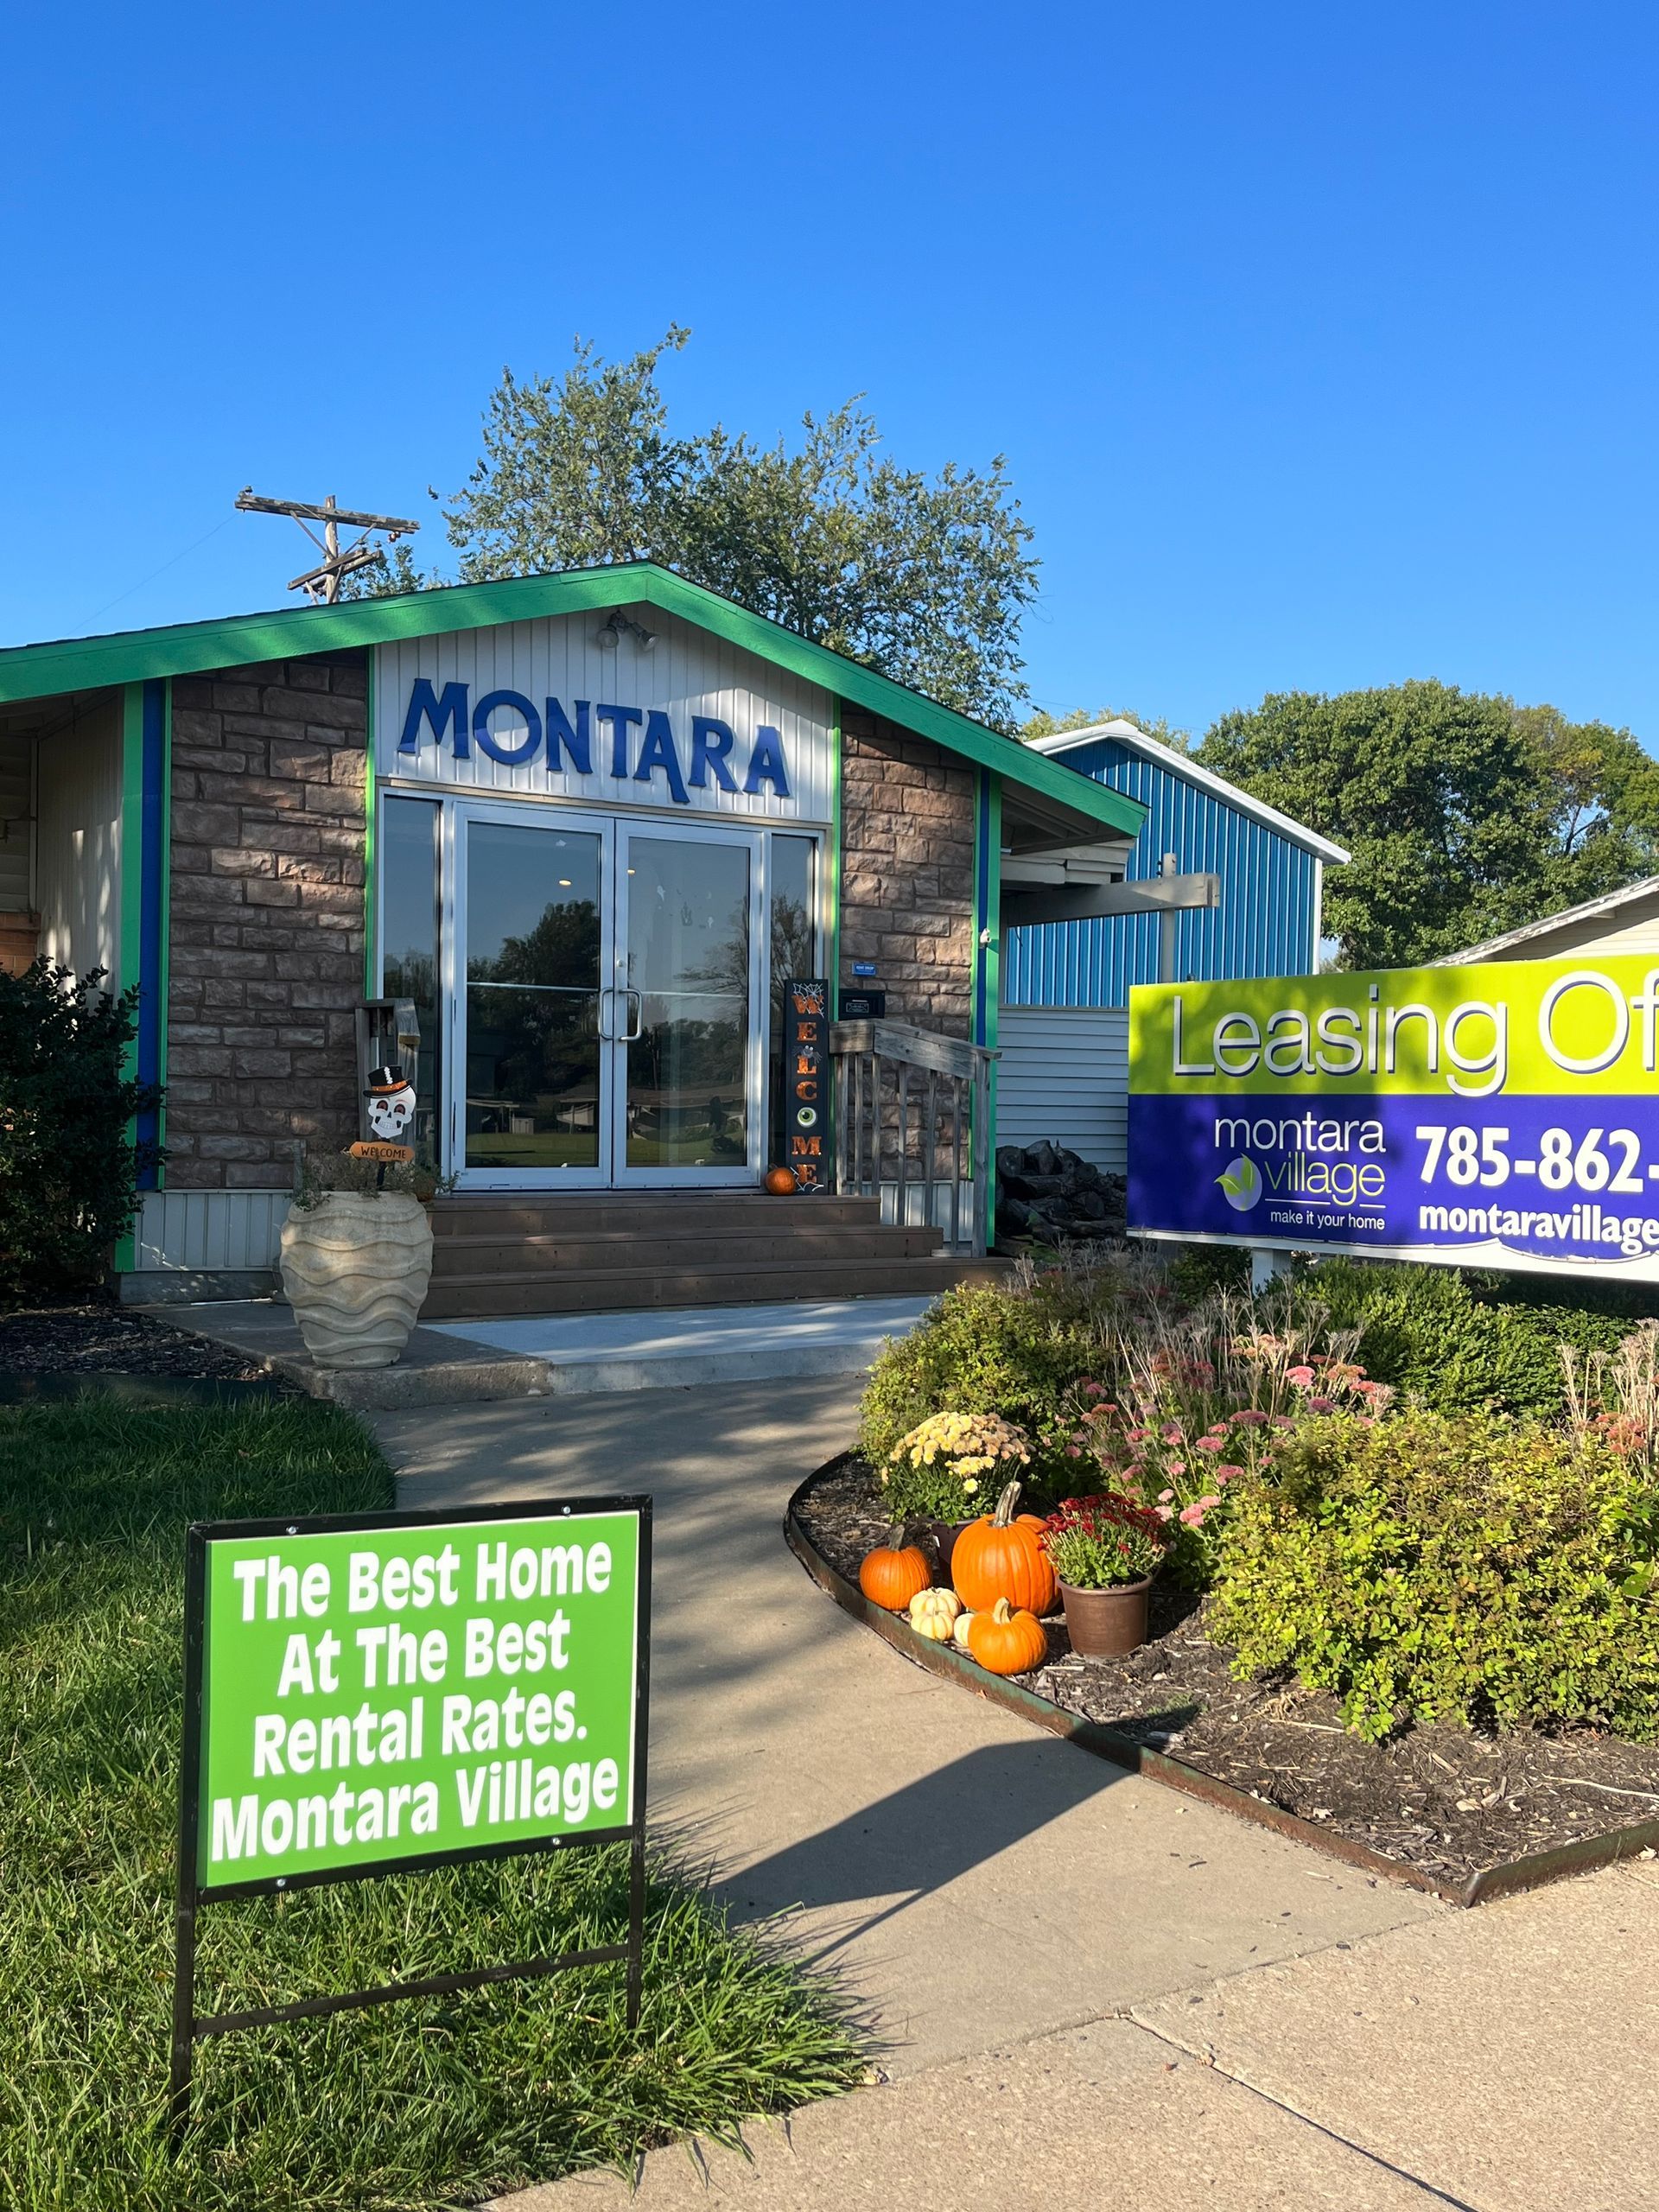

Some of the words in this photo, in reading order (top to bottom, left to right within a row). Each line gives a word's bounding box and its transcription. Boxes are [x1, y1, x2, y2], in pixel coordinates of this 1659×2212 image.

[397, 677, 791, 804] MONTARA
[1172, 983, 1508, 1097] Leasing
[1215, 1111, 1386, 1153] montara
[1264, 1151, 1386, 1205] village
[1270, 1210, 1303, 1224] make
[1306, 1210, 1314, 1225] it
[1317, 1214, 1345, 1229] your
[1348, 1213, 1386, 1230] home
[233, 1554, 330, 1622] The
[347, 1543, 461, 1614] Best
[475, 1541, 612, 1603] Home
[276, 1629, 340, 1697] At
[356, 1623, 448, 1688] The
[464, 1608, 570, 1678] Best
[253, 1696, 423, 1778] Rental
[442, 1686, 587, 1756] Rates.
[211, 1779, 439, 1862] Montara
[455, 1758, 619, 1827] Village
